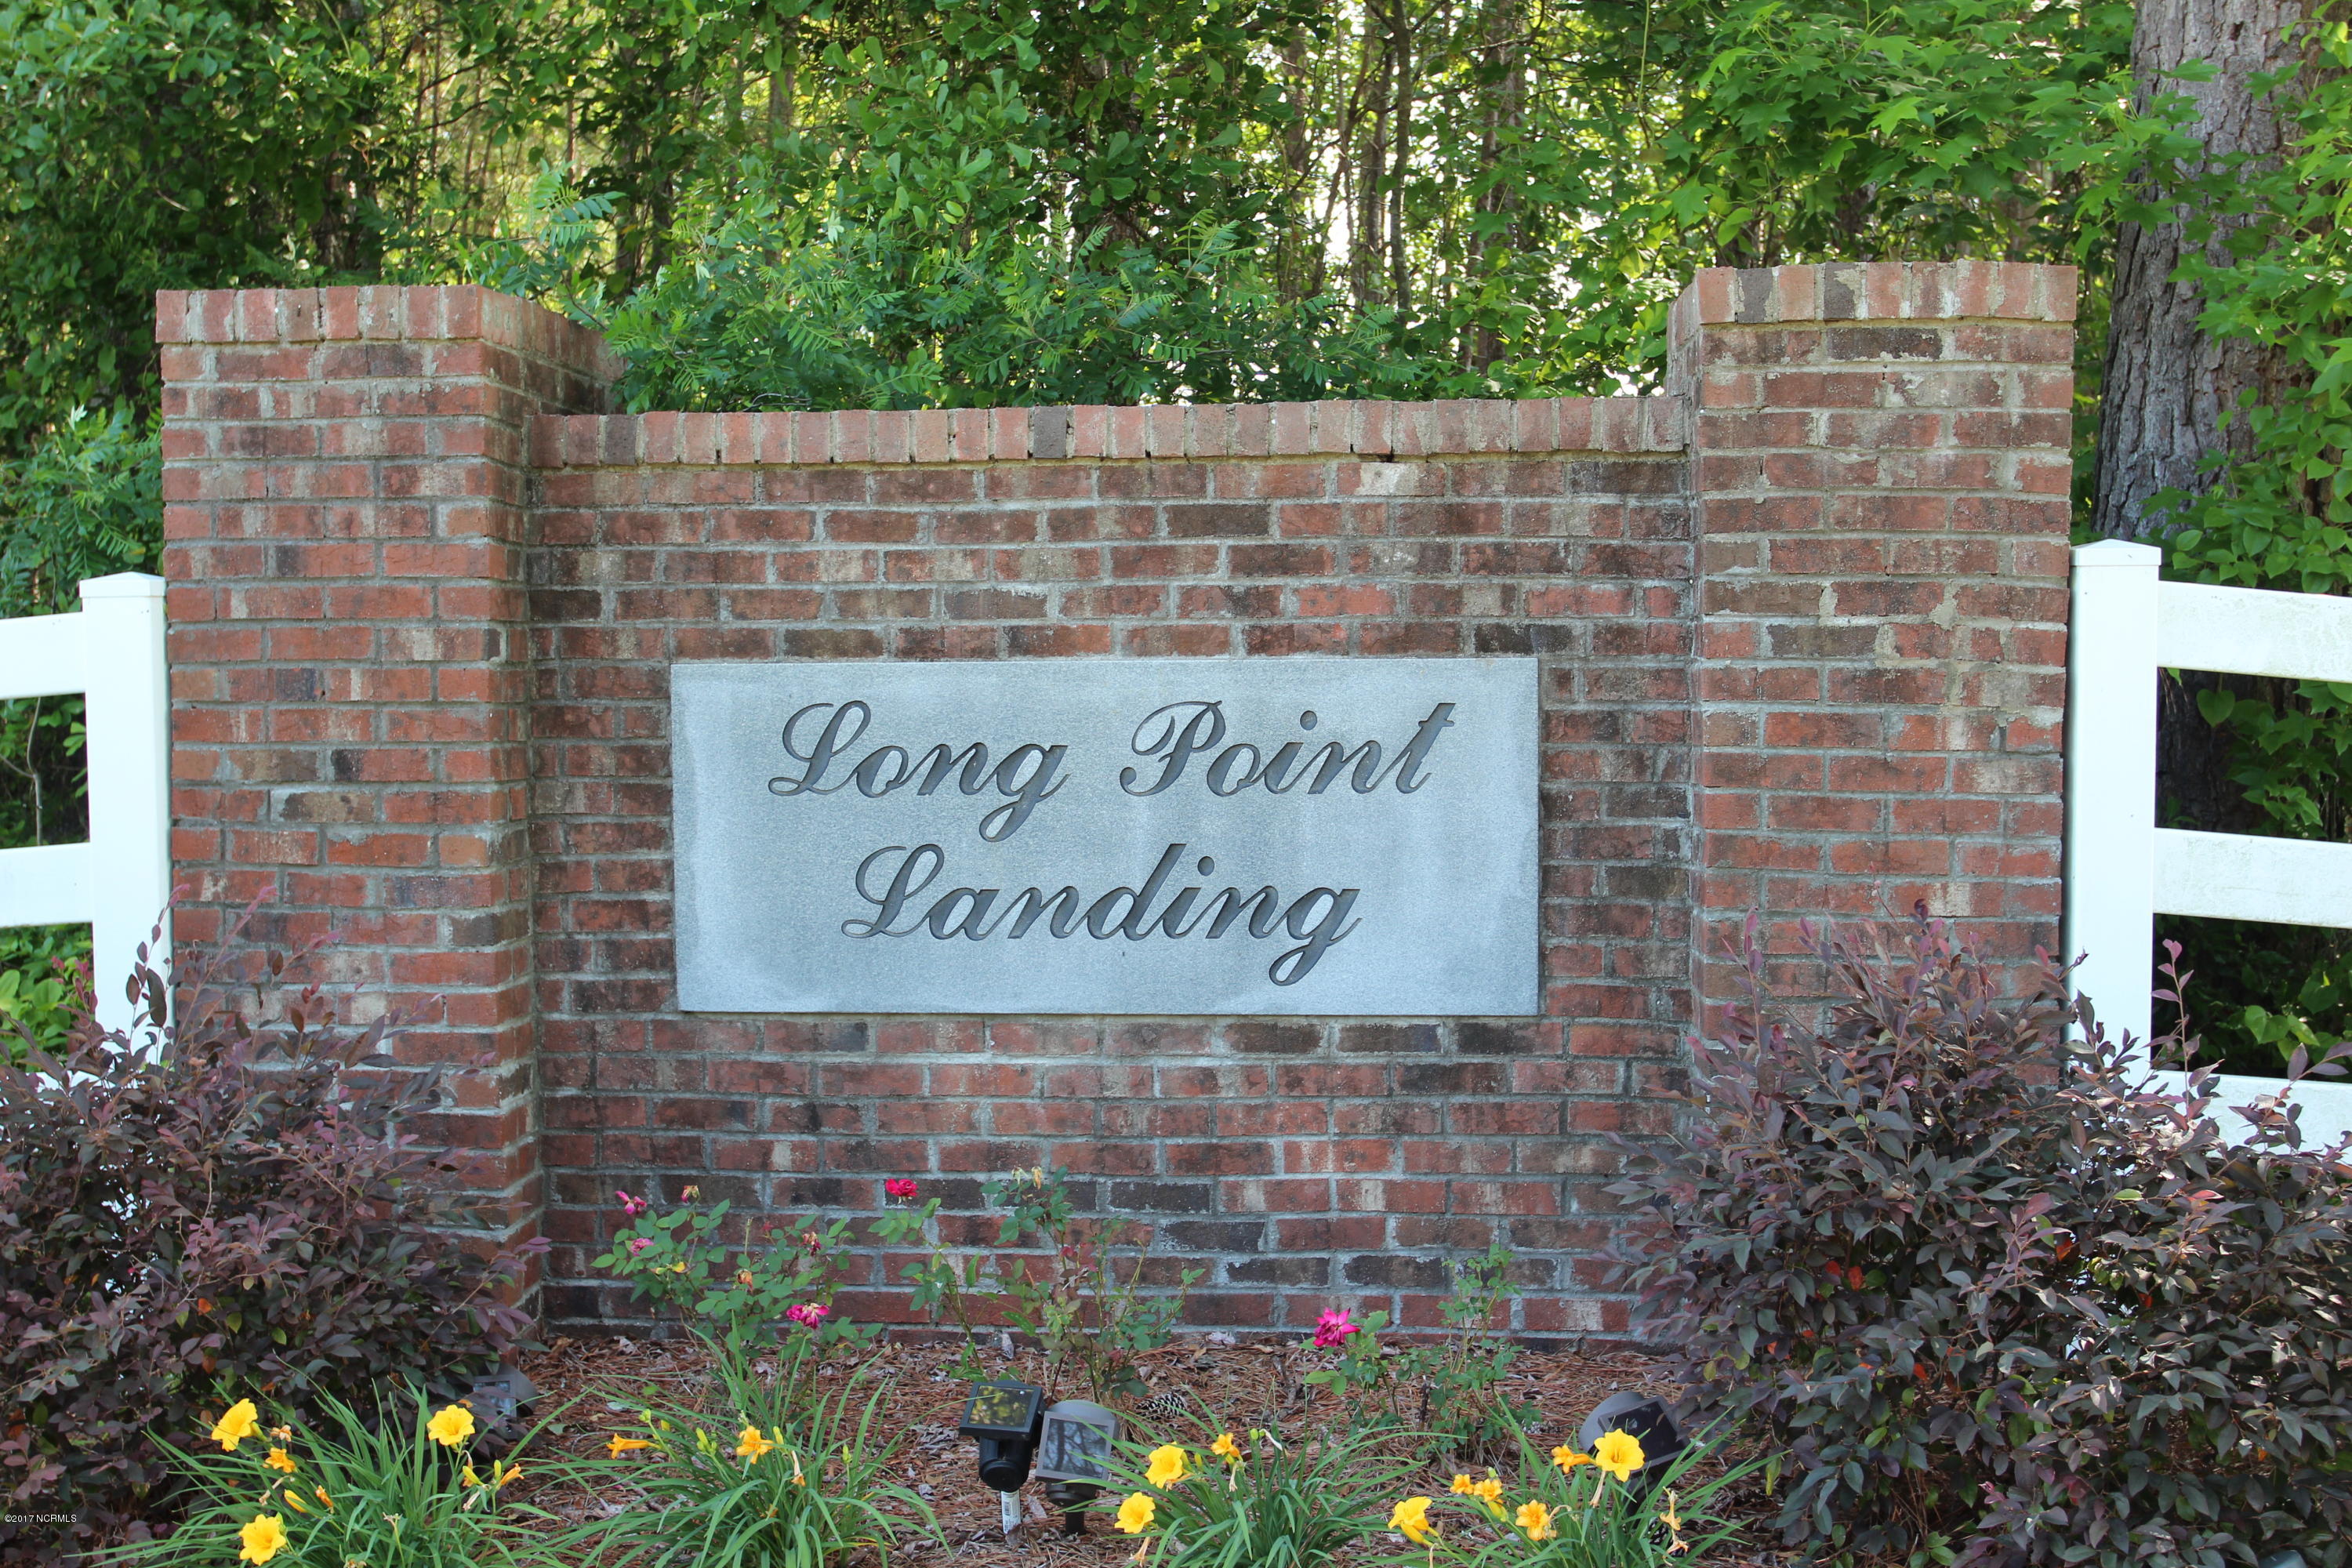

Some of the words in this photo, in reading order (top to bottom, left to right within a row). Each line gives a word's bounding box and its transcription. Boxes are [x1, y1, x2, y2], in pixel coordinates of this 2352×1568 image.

[768, 699, 1071, 843] Long
[1119, 699, 1456, 797] Point
[840, 843, 1363, 987] Landing
